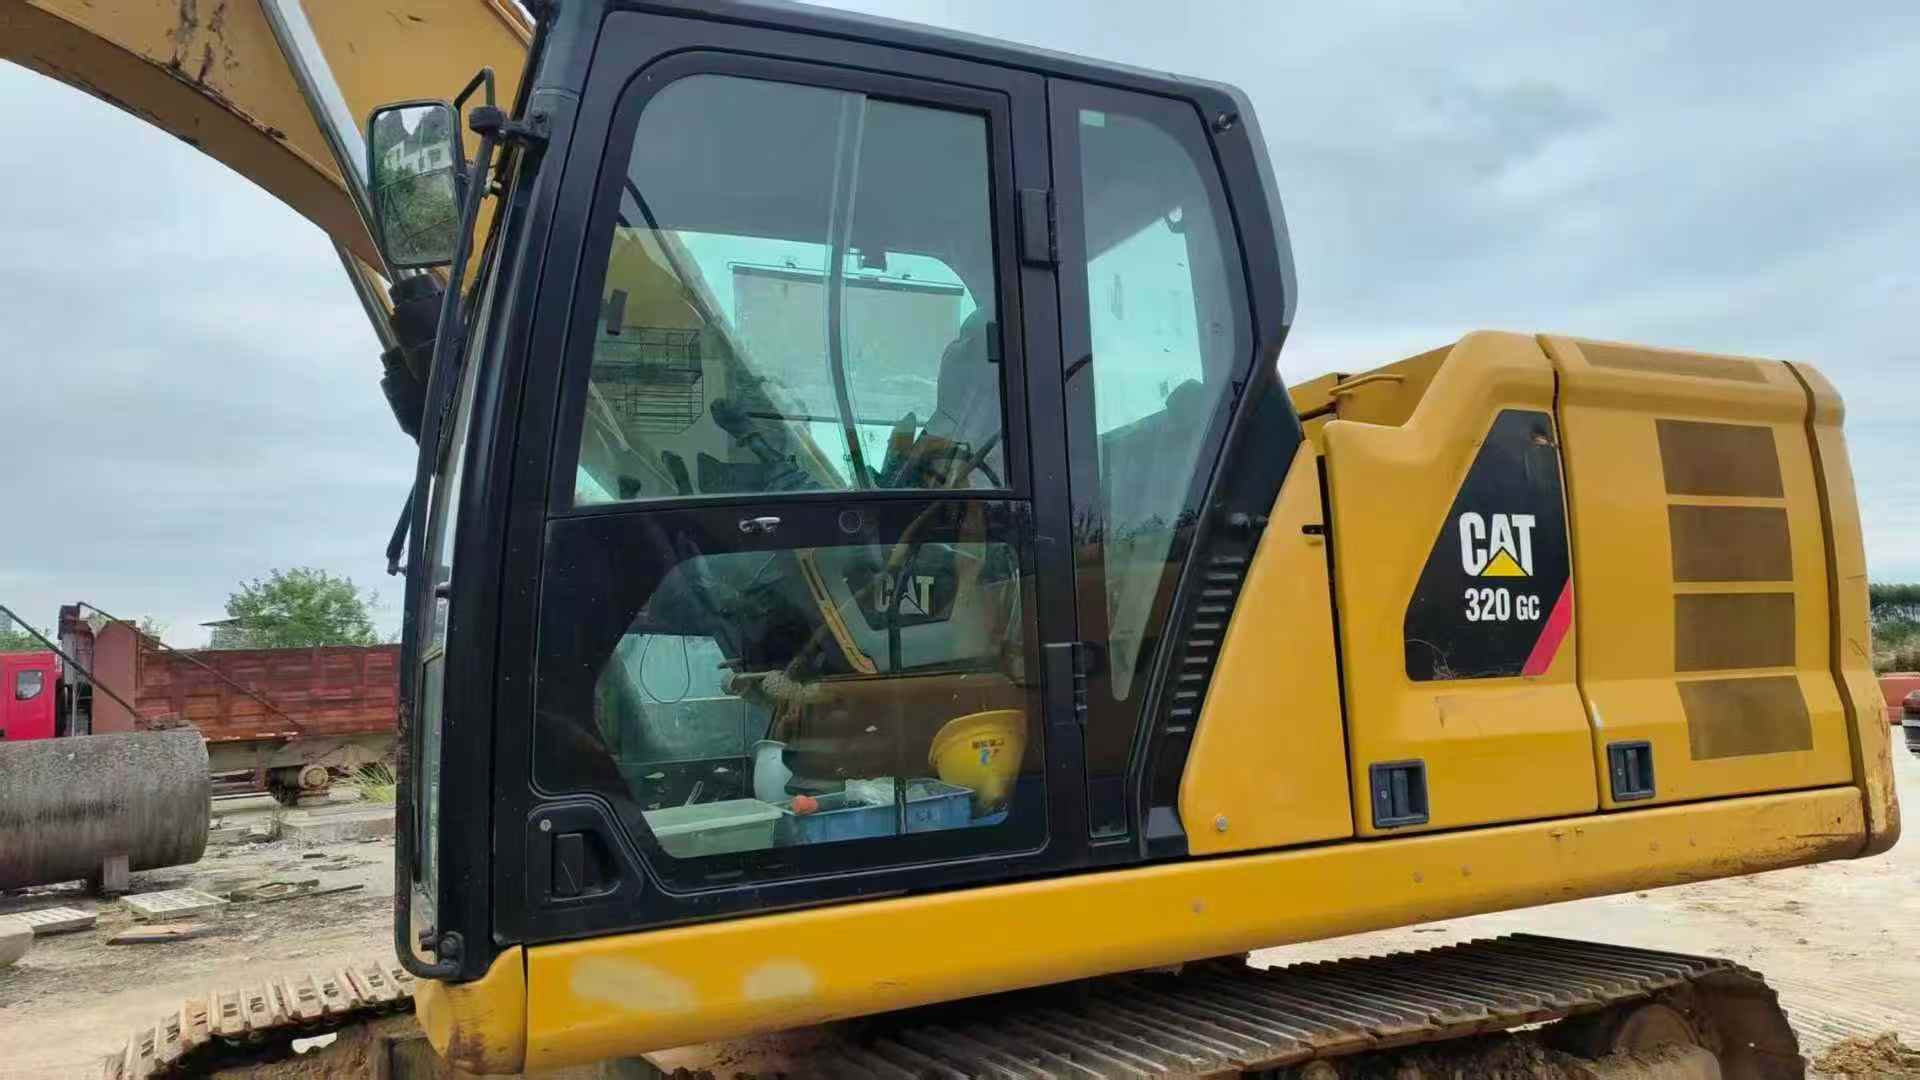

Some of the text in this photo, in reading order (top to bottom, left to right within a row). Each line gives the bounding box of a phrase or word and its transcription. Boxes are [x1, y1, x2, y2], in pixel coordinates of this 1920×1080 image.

[1459, 512, 1536, 576] CAT
[1464, 587, 1540, 621] 320 GC
